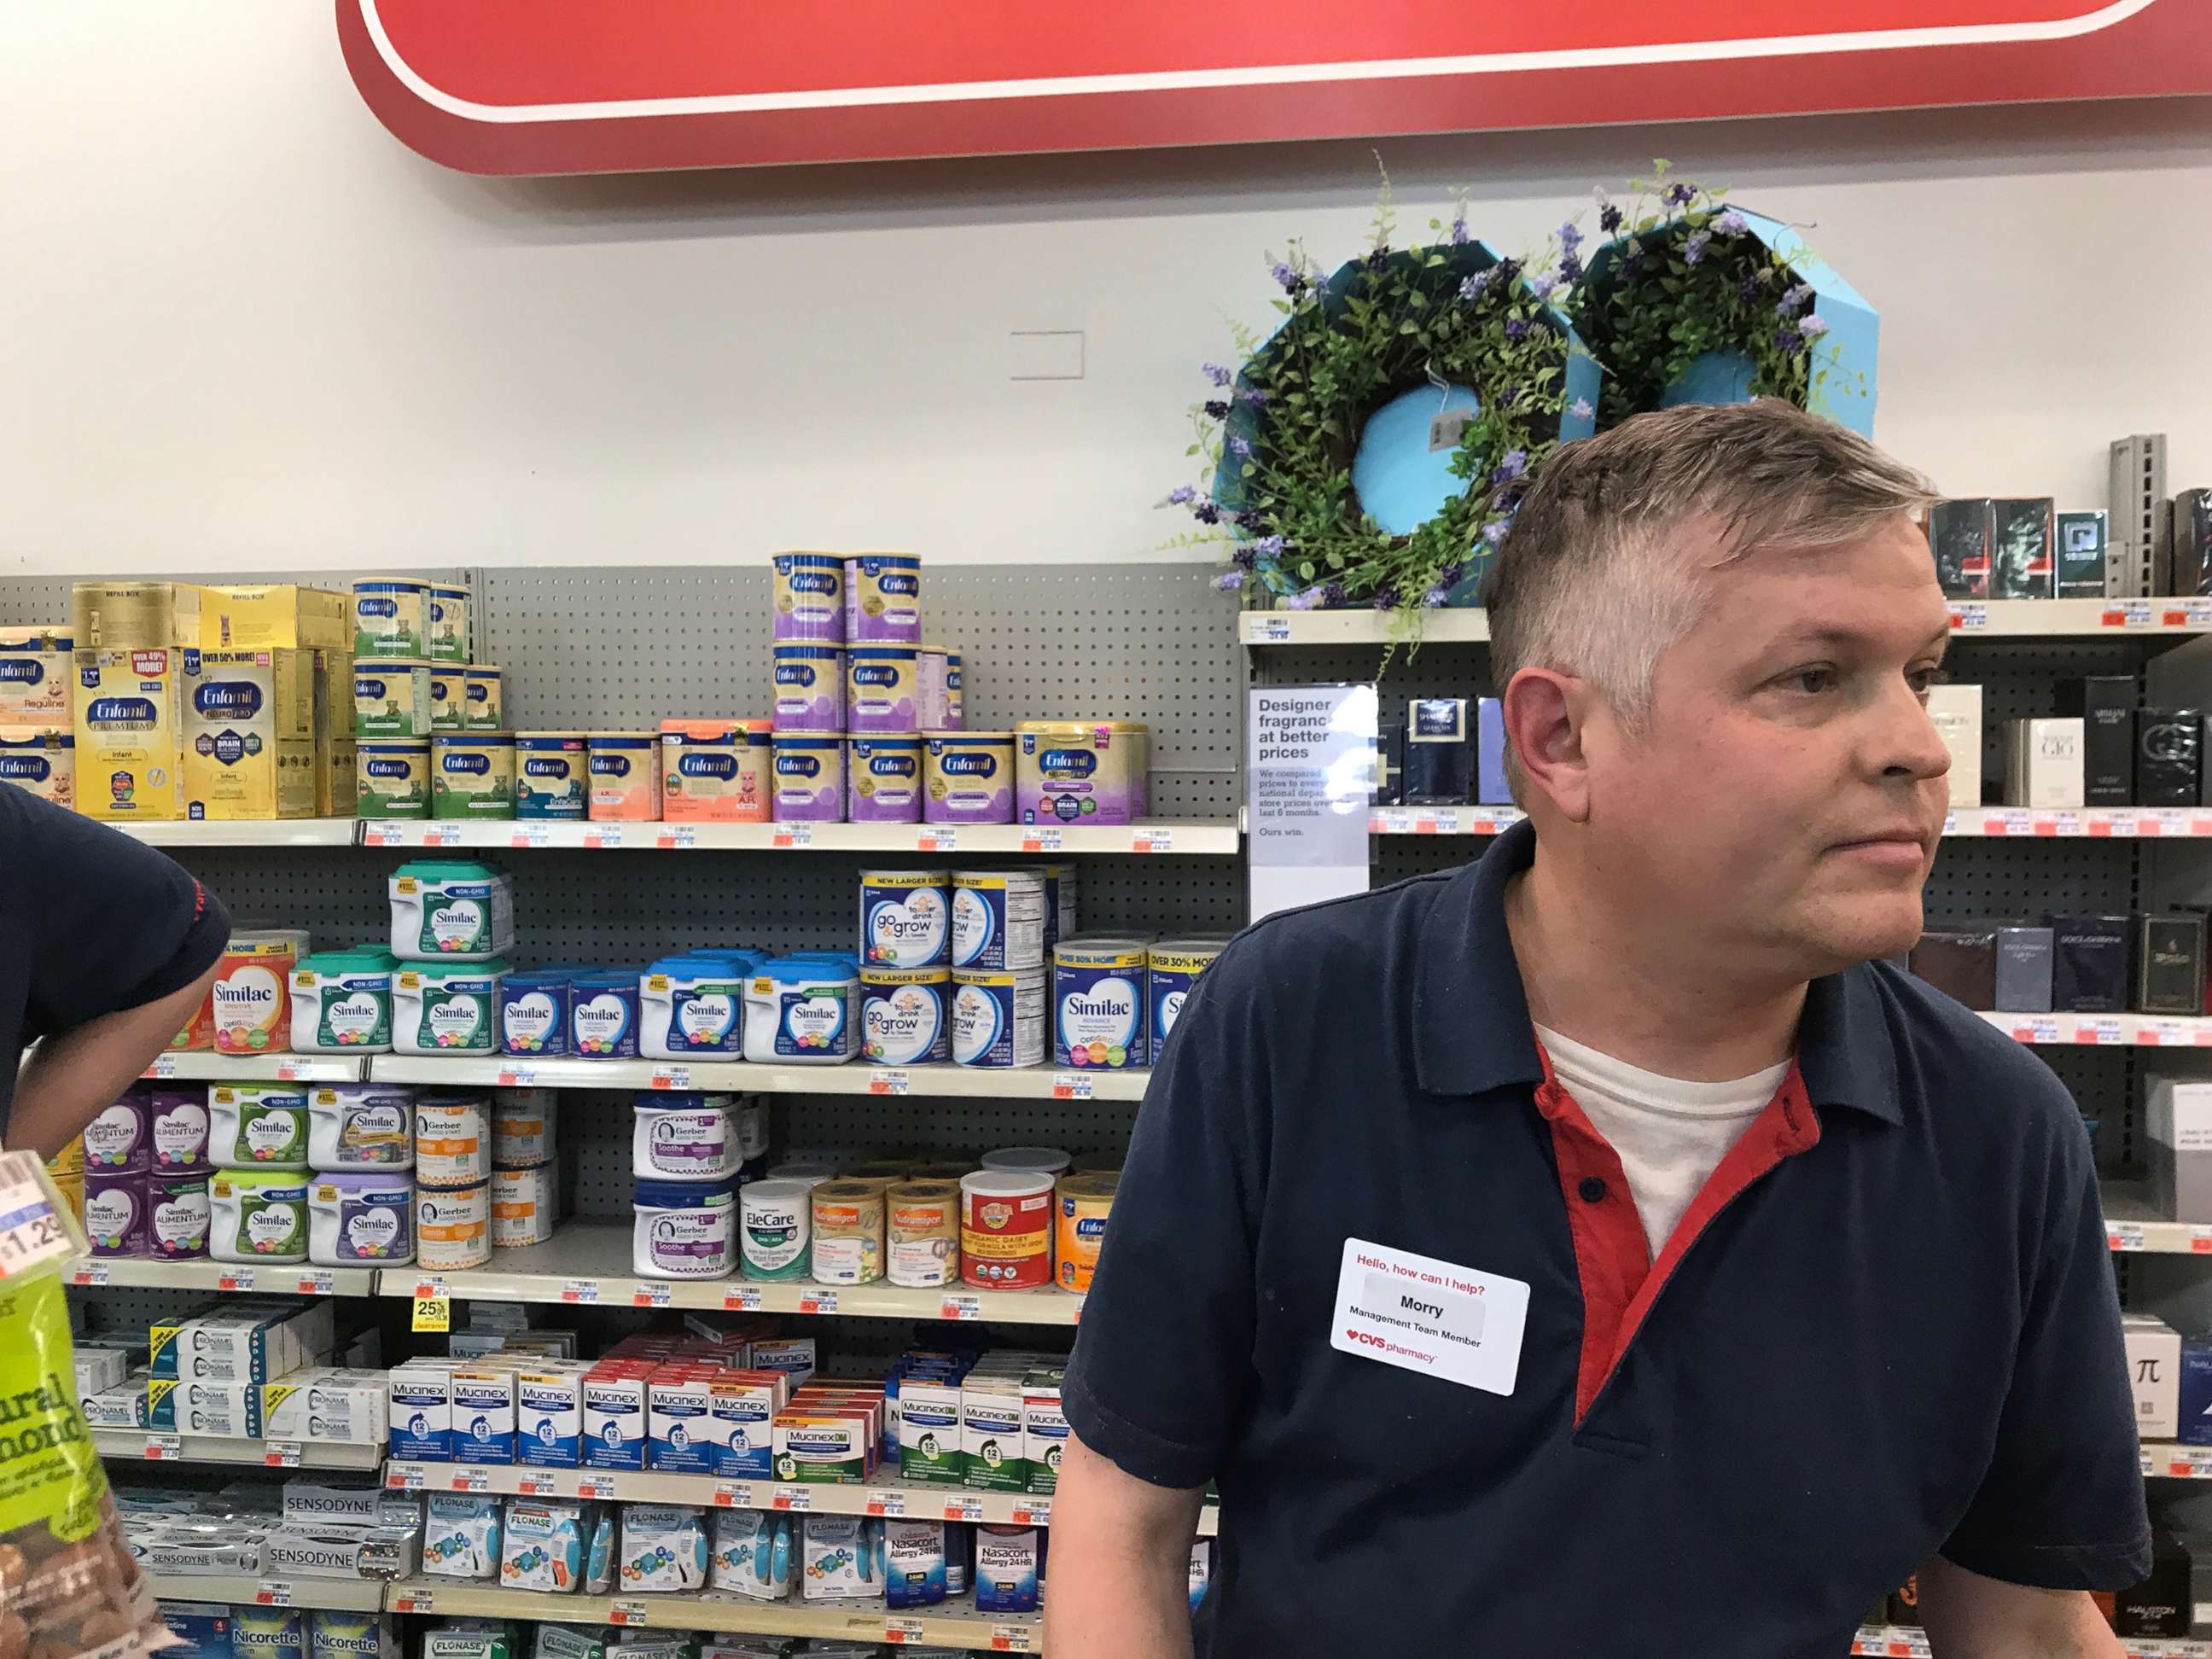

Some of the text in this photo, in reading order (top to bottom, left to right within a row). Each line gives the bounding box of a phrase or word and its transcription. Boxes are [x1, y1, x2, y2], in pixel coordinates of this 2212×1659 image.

[795, 575, 834, 589] Enfamil
[360, 601, 393, 615] Enfamil
[776, 669, 811, 682] Enfamil
[855, 670, 894, 682] Enfamil
[204, 689, 253, 704] Enfamil
[97, 703, 148, 718] Enfamil
[1259, 699, 1331, 713] Designer
[1259, 731, 1329, 742] at better
[1259, 747, 1308, 760] prices
[370, 761, 406, 774] Enfamil
[445, 755, 485, 770] Enfamil
[527, 761, 565, 774] Enfamil
[591, 758, 626, 771] Enfamil
[684, 758, 732, 772] Enfamil
[778, 759, 816, 771] Enfamil
[874, 760, 913, 771] Enfamil
[946, 757, 990, 771] Enfamil
[1045, 754, 1089, 768] Enfamil
[1276, 770, 1322, 779] compared
[1259, 781, 1287, 789] prices
[1298, 790, 1327, 799] depar
[1284, 800, 1312, 808] prices
[1259, 828, 1304, 836] Ours win.
[436, 911, 477, 924] Similac
[877, 915, 896, 928] go
[894, 922, 932, 937] grow
[1171, 957, 1190, 968] 30%
[215, 983, 272, 1002] Similac
[333, 1004, 375, 1017] Similac
[434, 1006, 475, 1019] Similac
[507, 1004, 550, 1019] Similac
[686, 1003, 727, 1017] Similac
[794, 1006, 836, 1020] Similac
[1068, 997, 1129, 1016] Similac
[578, 1006, 620, 1021] Similac
[868, 1010, 883, 1024] go
[881, 1018, 919, 1035] grow
[163, 1121, 191, 1129] Similac
[252, 1121, 292, 1133] Similac
[357, 1115, 395, 1127] Similac
[428, 1121, 462, 1130] Gerber
[676, 1126, 707, 1136] Gerber
[658, 1144, 684, 1152] Soothe
[271, 1190, 301, 1199] NON-GMO
[157, 1213, 208, 1223] ALIMENTUM
[166, 1208, 195, 1216] Similac
[439, 1207, 472, 1216] Gerber
[253, 1214, 292, 1226] Similac
[353, 1217, 394, 1231] Similac
[747, 1213, 795, 1226] EleCare
[676, 1225, 708, 1234] Gerber
[658, 1243, 685, 1251] Soothe
[1357, 1254, 1485, 1296] Hello, how can I help?
[418, 1301, 437, 1315] 25
[1400, 1295, 1444, 1319] Morry
[1350, 1306, 1481, 1348] Management Team Member
[1359, 1333, 1435, 1365] CVS pharmacy
[758, 1353, 810, 1365] Mucinex
[393, 1383, 445, 1397] Mucinex
[456, 1386, 508, 1400] Mucinex
[522, 1388, 573, 1402] Mucinex
[588, 1390, 638, 1404] Mucinex
[653, 1393, 706, 1406] Mucinex
[714, 1398, 767, 1412] Mucinex
[415, 1422, 425, 1431] 12
[476, 1423, 487, 1433] 12
[542, 1427, 553, 1436] 12
[607, 1429, 618, 1439] 12
[673, 1432, 684, 1441] 12
[735, 1438, 746, 1447] 12
[987, 1448, 998, 1457] 12
[1051, 1454, 1062, 1463] 12
[781, 1461, 792, 1470] 12
[288, 1496, 373, 1512] SENSODYNE
[435, 1498, 475, 1510] FLONASE
[511, 1516, 552, 1528] FLONASE
[630, 1513, 670, 1523] FLONASE
[721, 1516, 754, 1528] FLONASE
[811, 1522, 851, 1533] FLONASE
[892, 1537, 938, 1549] Nasacort
[270, 1547, 354, 1568] SENSODYNE
[890, 1548, 918, 1559] Allergy
[981, 1547, 1030, 1558] Nasacort
[152, 1554, 211, 1565] SENSODYNE
[981, 1557, 1009, 1568] Allergy
[233, 1629, 299, 1644] Nicorette
[314, 1633, 378, 1652] Nicorette
[436, 1641, 481, 1651] FLONASE
[546, 1636, 583, 1654] FLONASE
